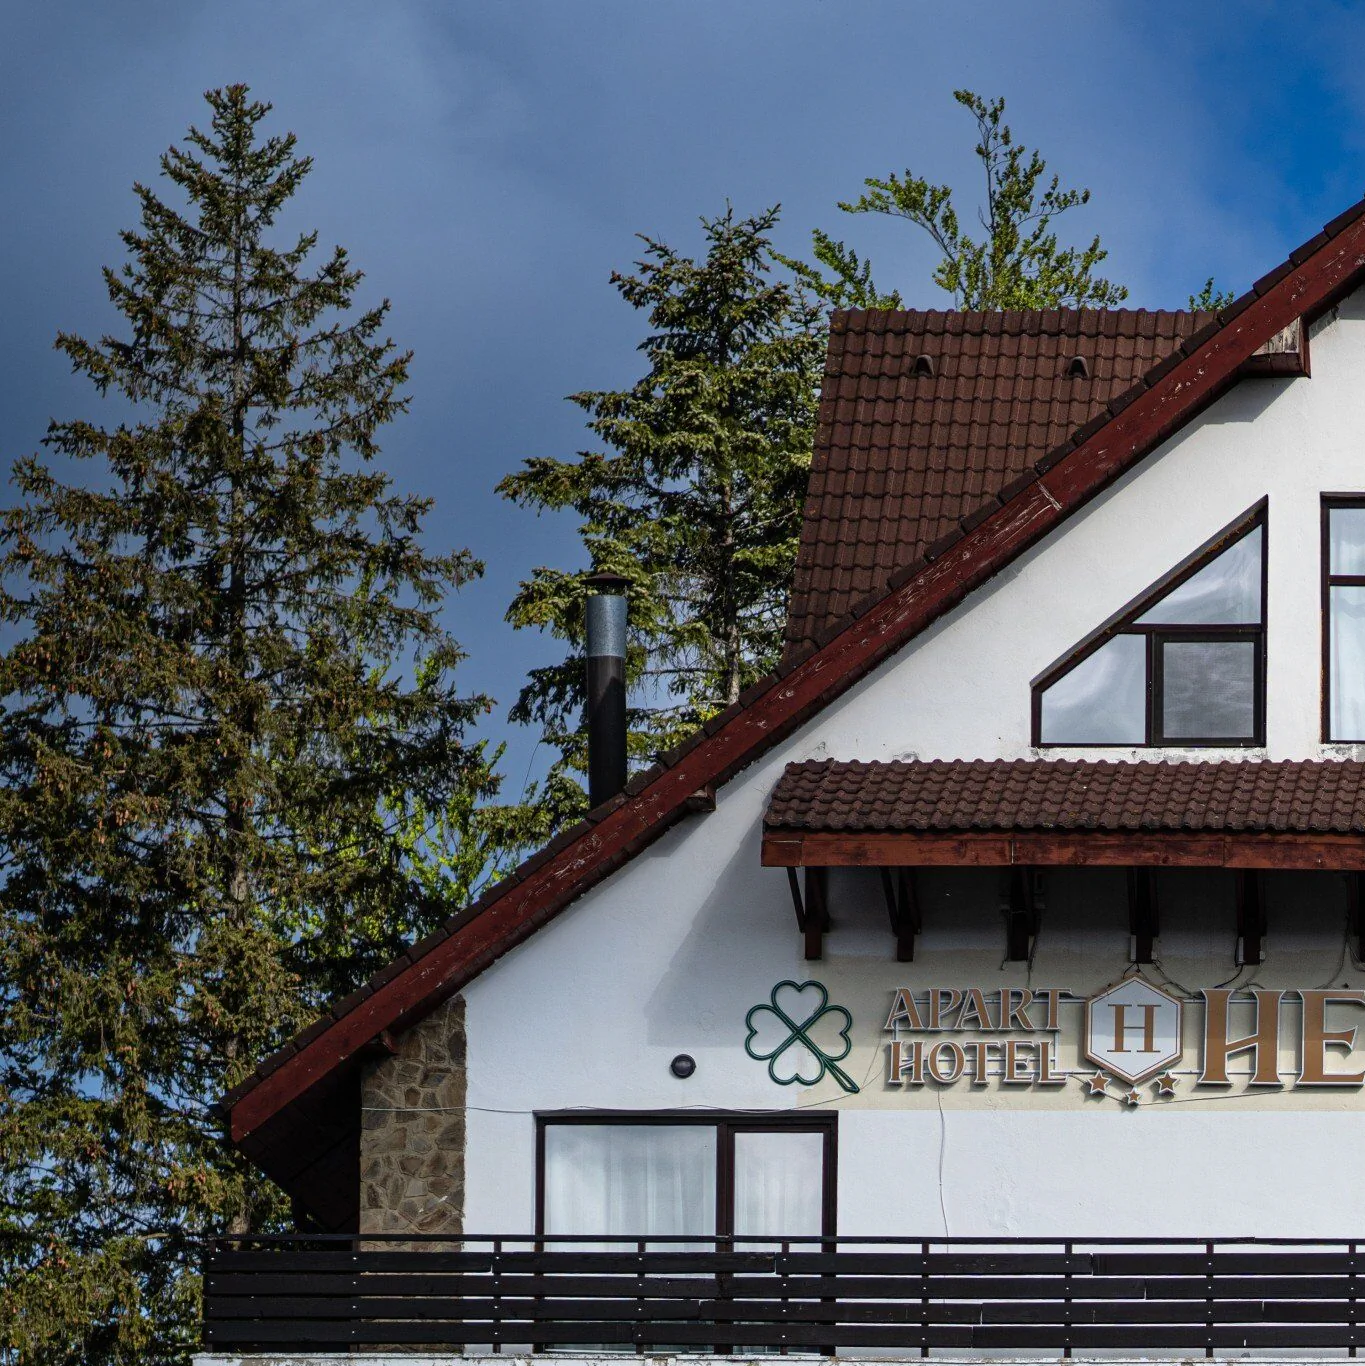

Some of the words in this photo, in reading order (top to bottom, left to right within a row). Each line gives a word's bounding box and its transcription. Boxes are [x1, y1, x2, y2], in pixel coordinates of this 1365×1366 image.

[884, 987, 1073, 1031] APART
[1106, 1003, 1162, 1053] H
[887, 1039, 1070, 1085] HOTEL
